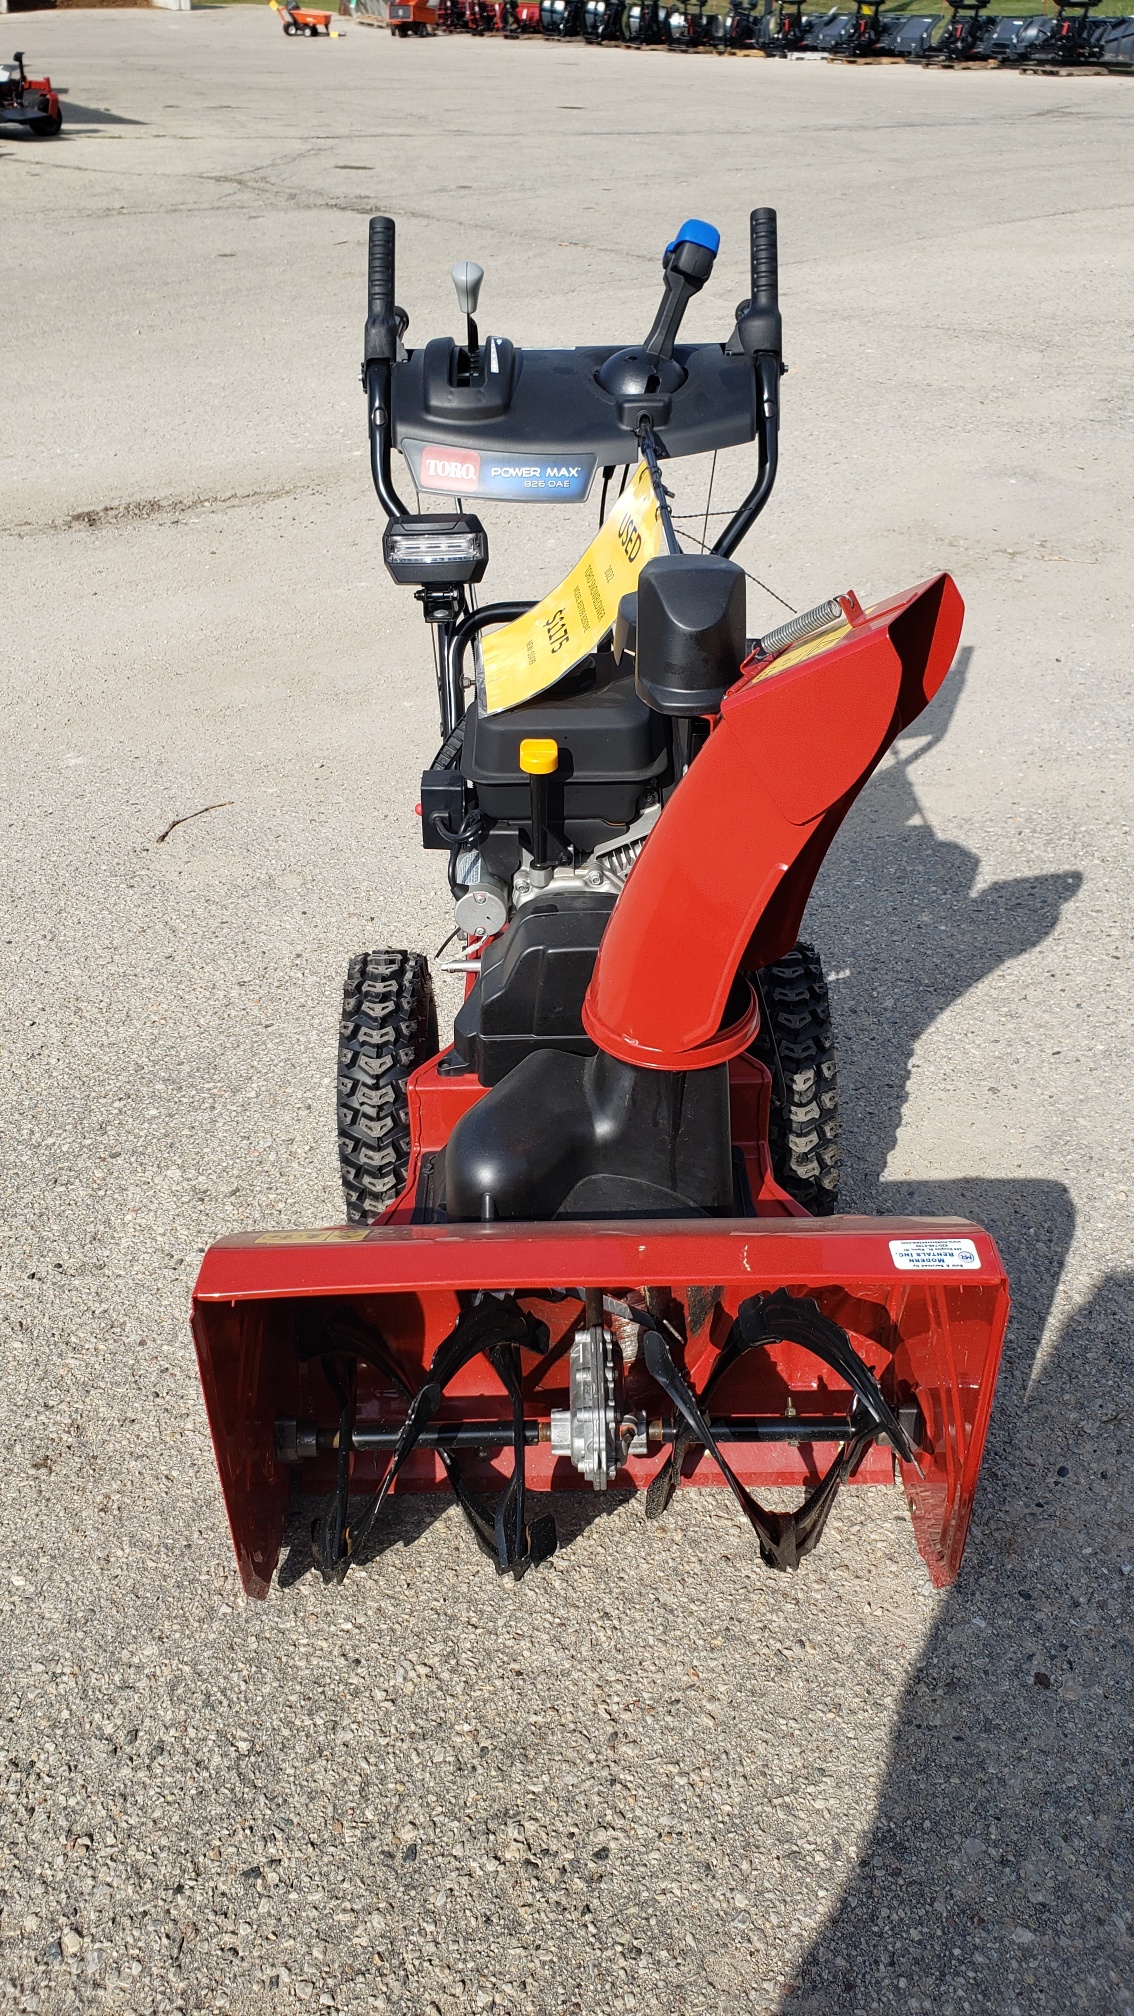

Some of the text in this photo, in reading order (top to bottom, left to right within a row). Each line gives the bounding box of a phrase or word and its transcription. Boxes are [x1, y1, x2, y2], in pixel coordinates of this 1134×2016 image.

[426, 459, 475, 480] TORO
[491, 467, 579, 478] POWER MAX
[524, 480, 570, 488] 826 OAE
[618, 512, 642, 563] USED
[588, 579, 606, 622] SNOWBLOWER
[542, 608, 570, 654] $1175
